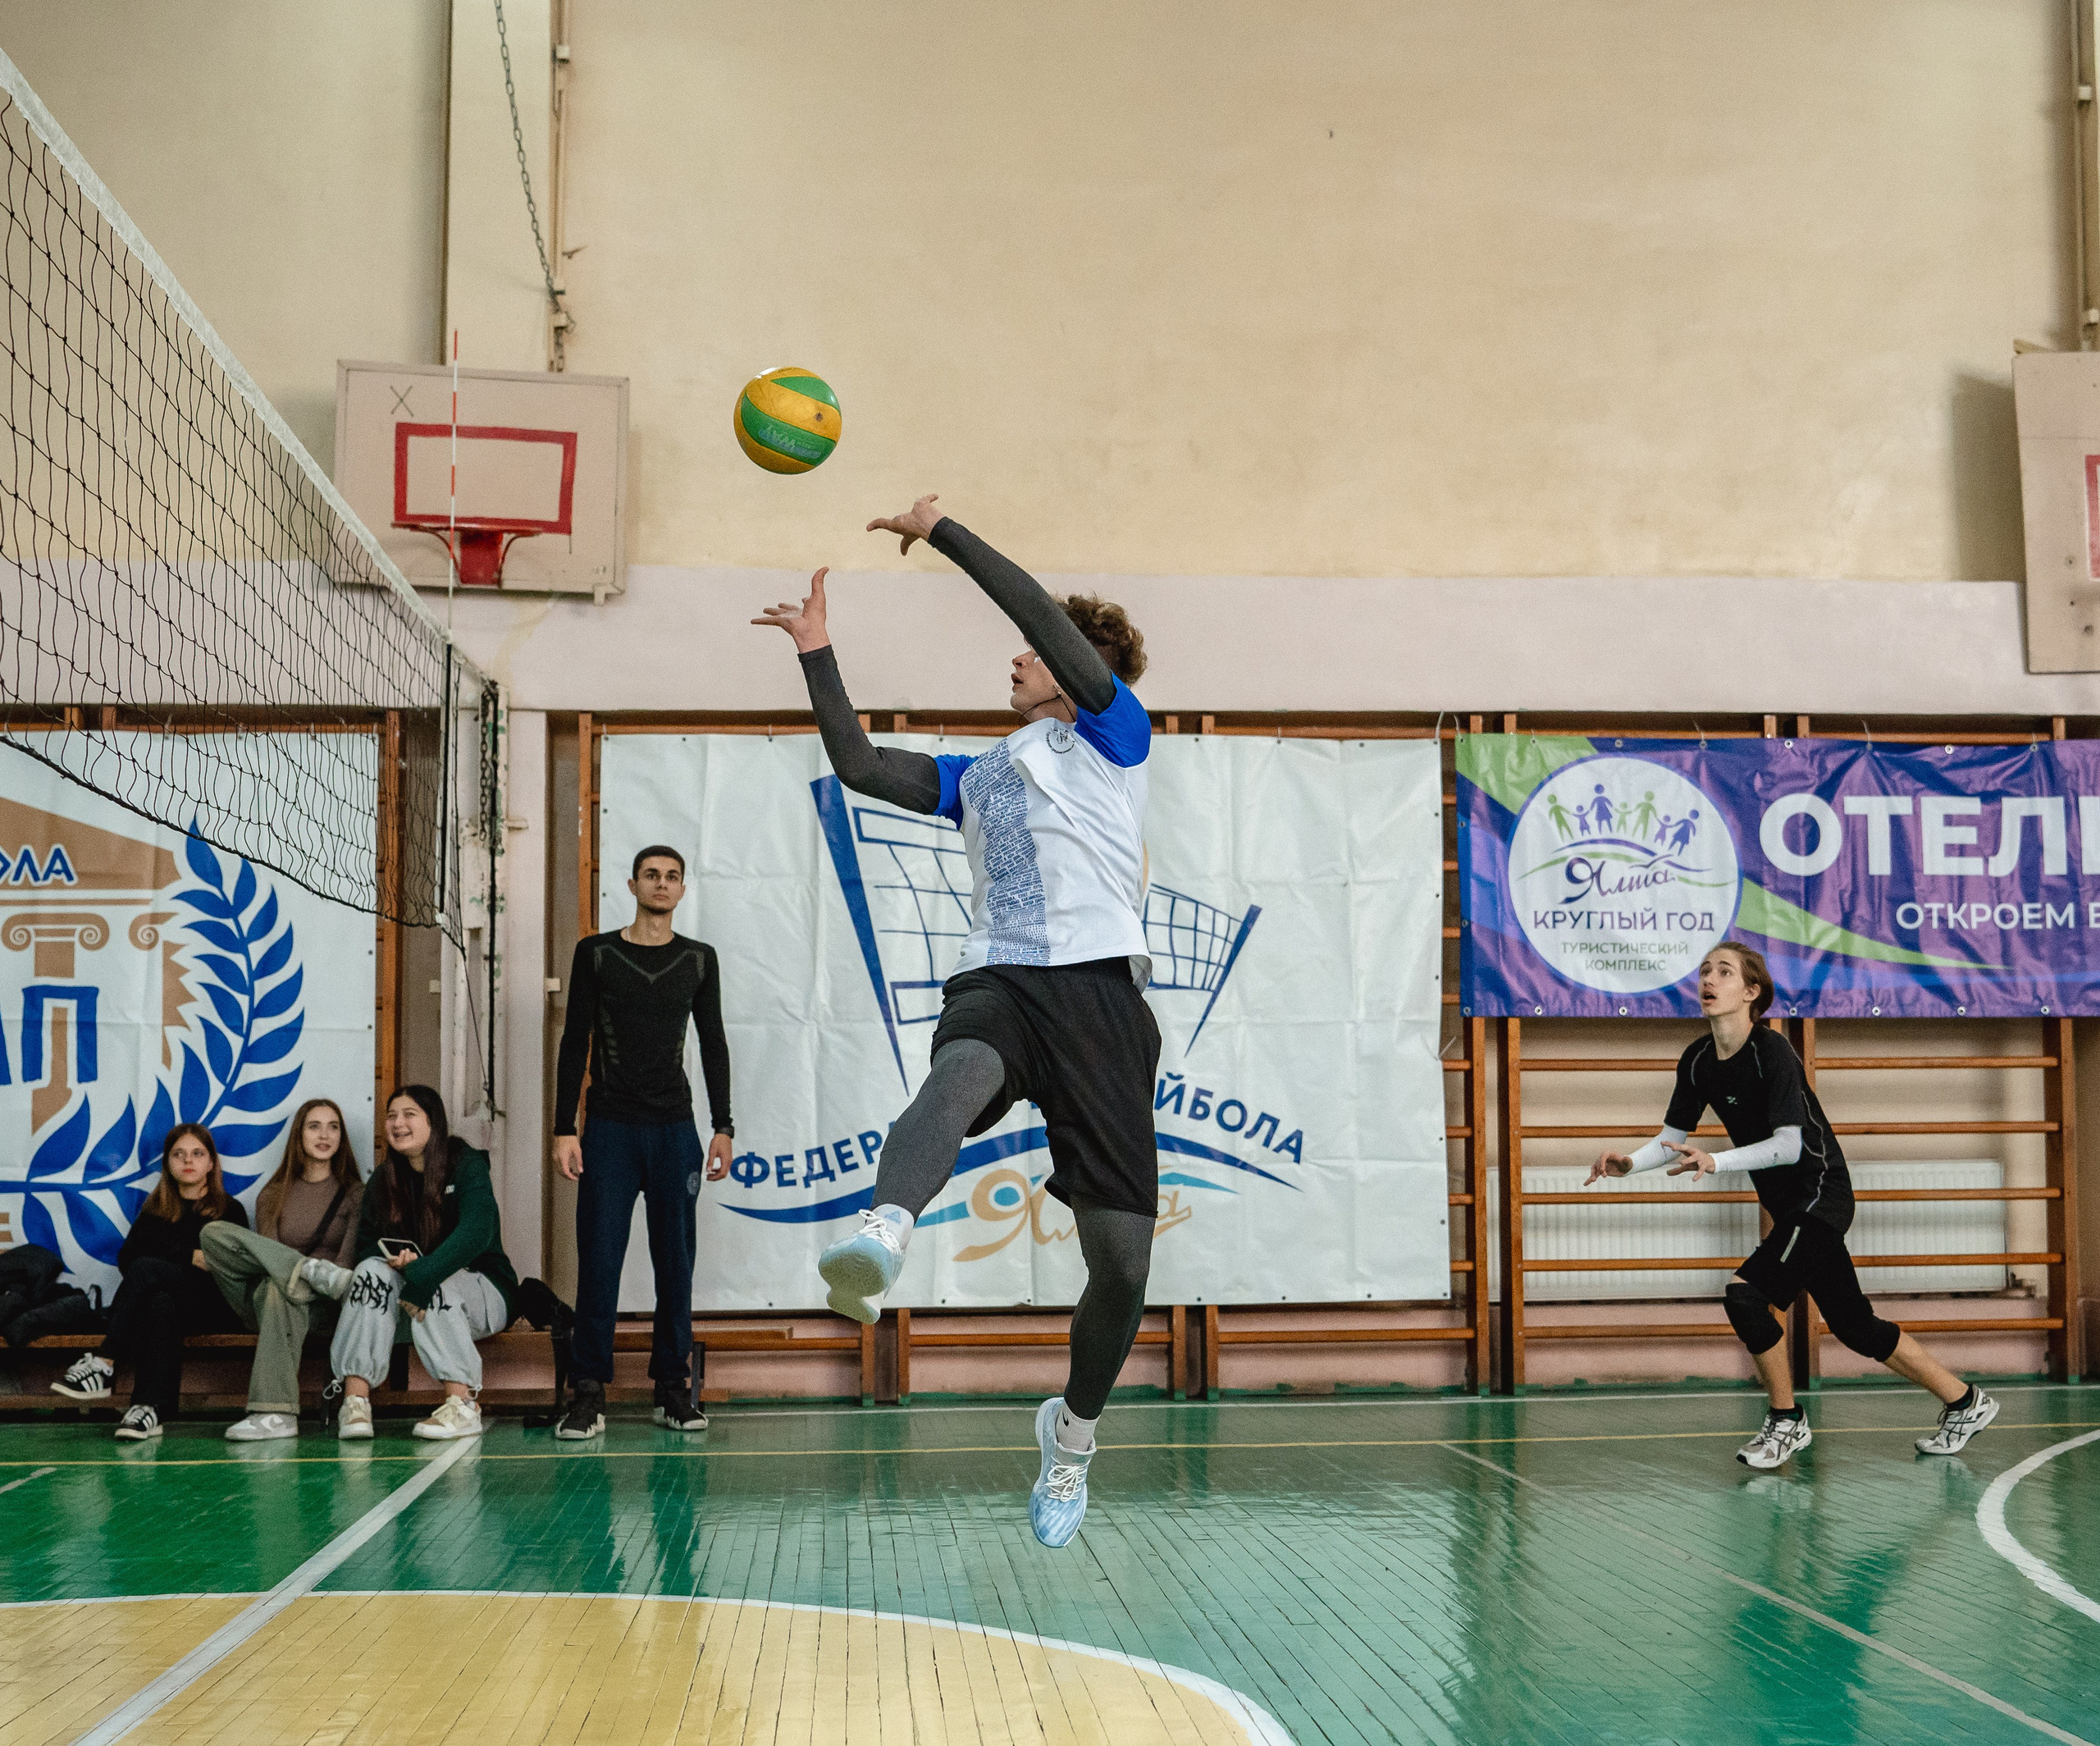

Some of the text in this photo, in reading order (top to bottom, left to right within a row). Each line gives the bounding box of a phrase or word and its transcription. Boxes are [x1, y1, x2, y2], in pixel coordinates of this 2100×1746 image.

[1533, 907, 1714, 931] КРУГЛЫЙ ГОД
[1896, 902, 2075, 930] ОТКРОЕМ
[1562, 941, 1688, 955] ТУРИСТИЧЕСКИЙ
[1585, 958, 1667, 971] КОМПЛЕКС
[0, 985, 98, 1085] П
[731, 1072, 1303, 1190] ФЕДЕР ЙБОЛА
